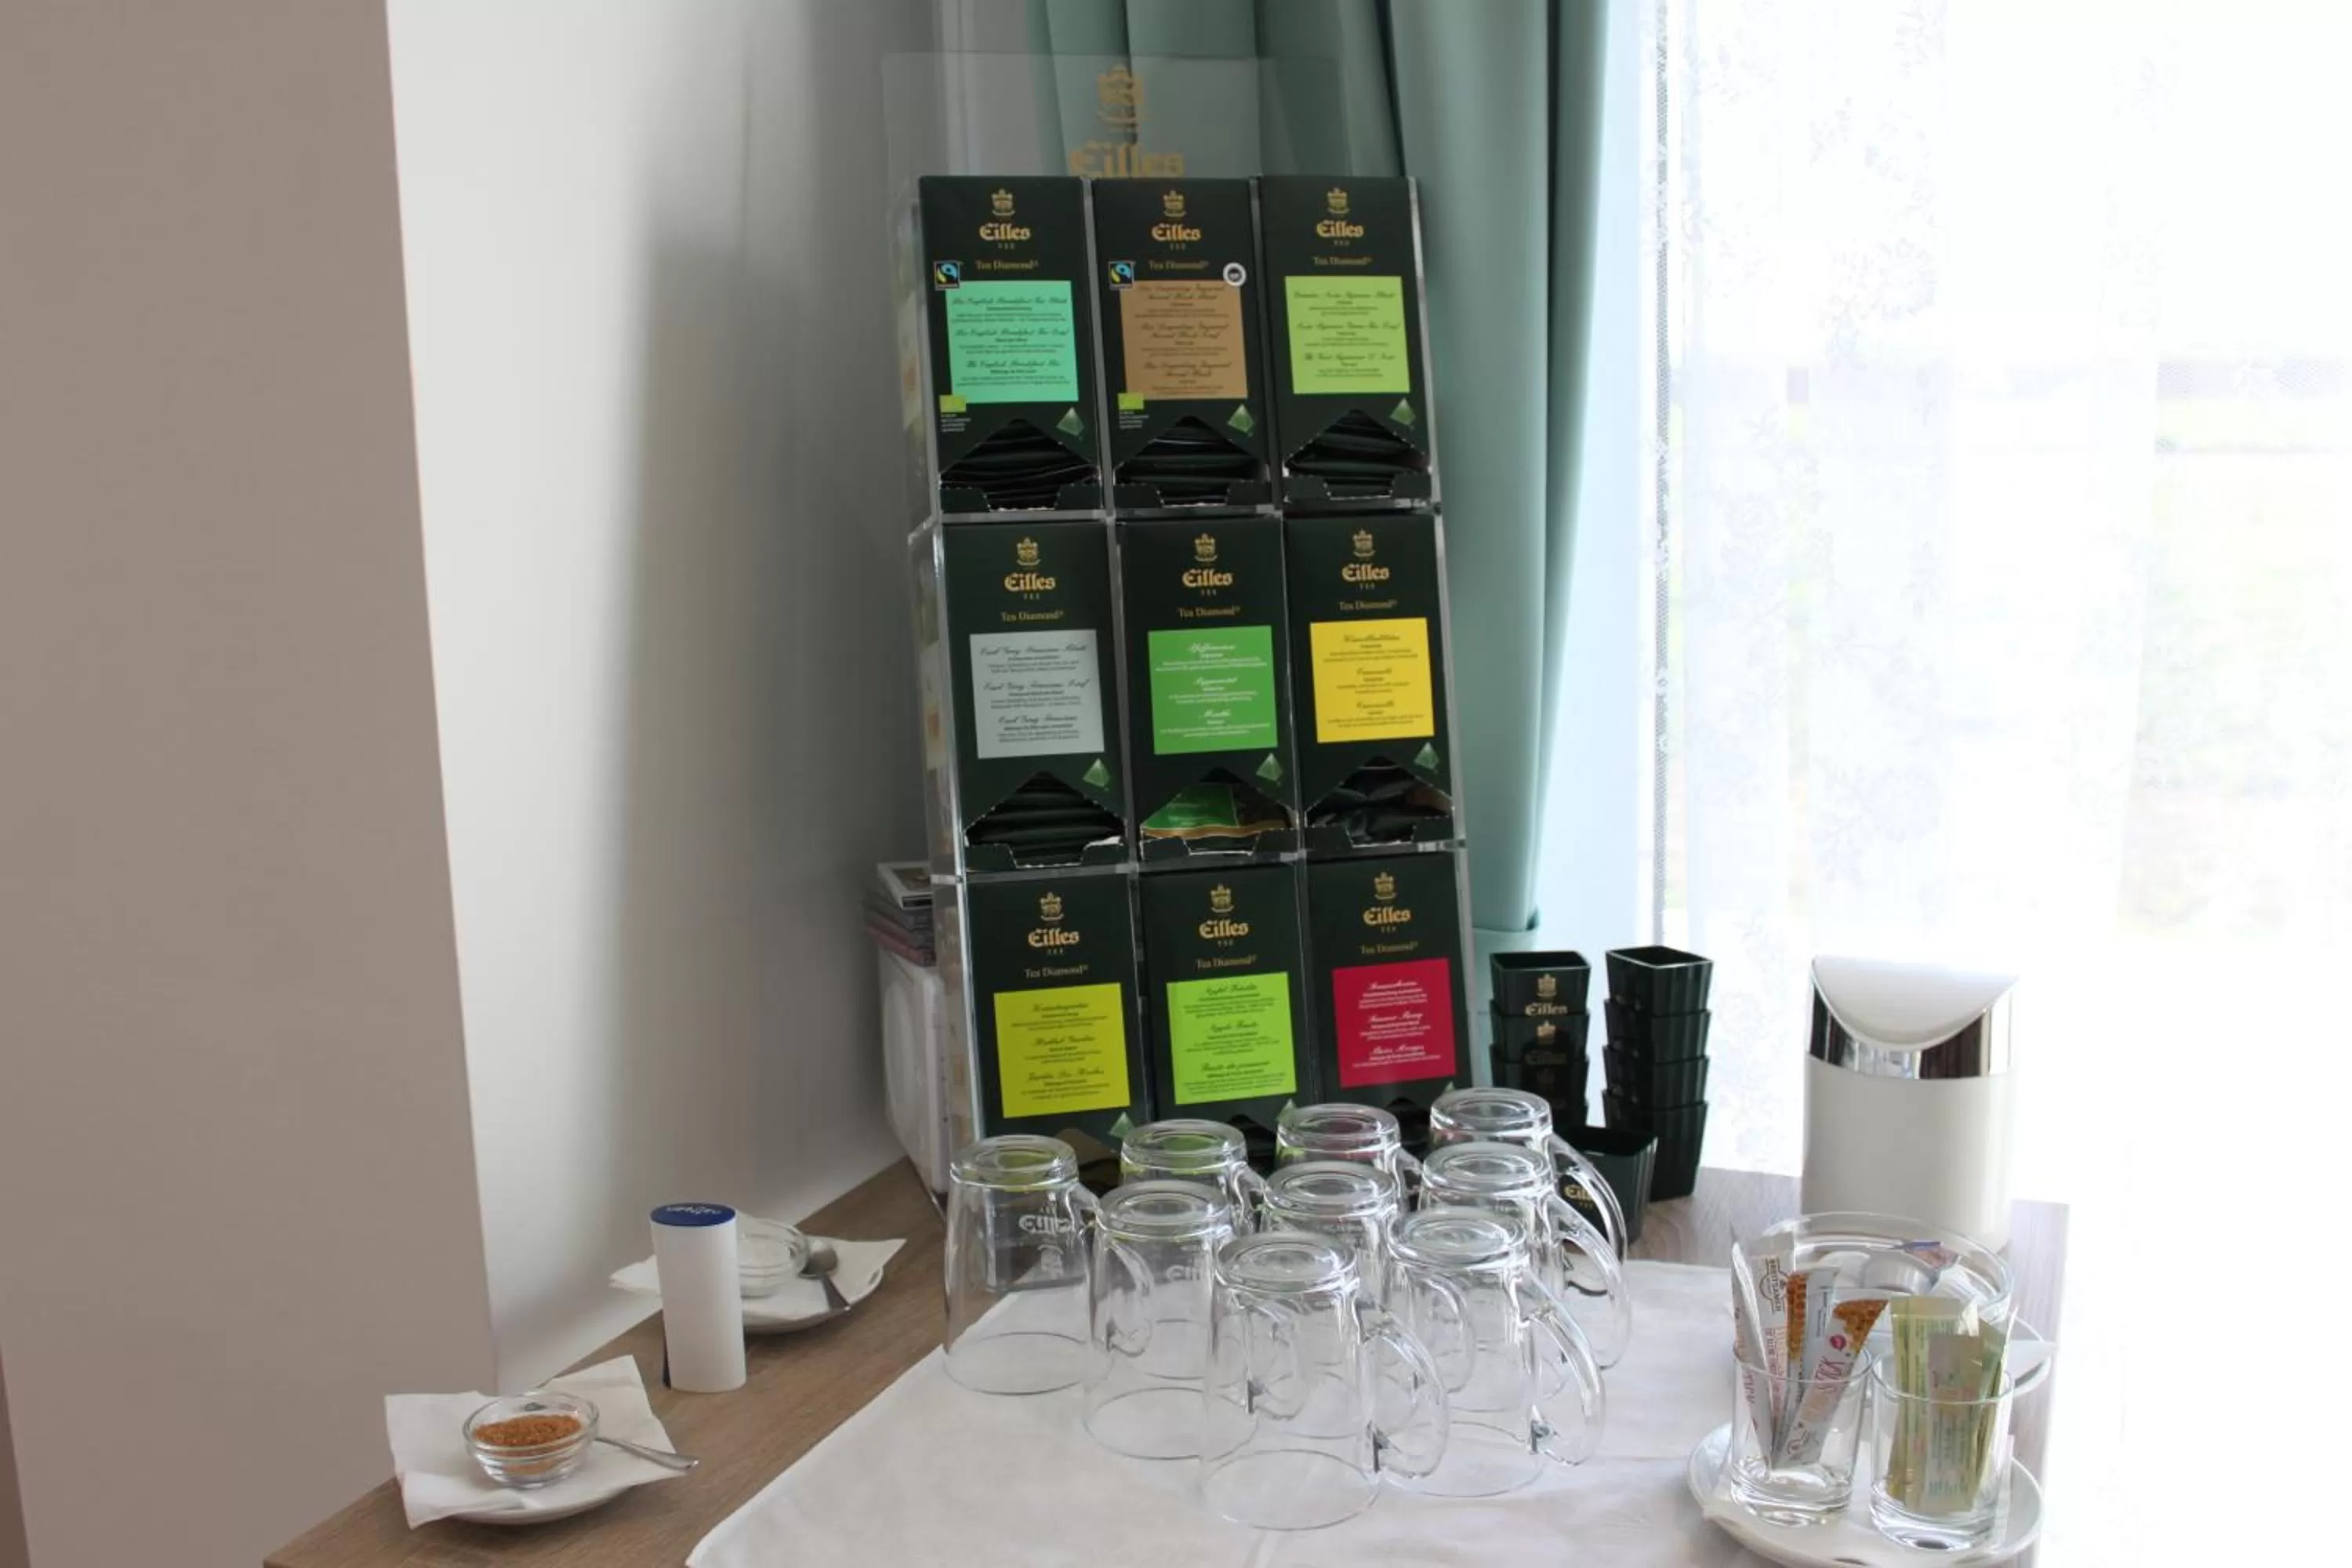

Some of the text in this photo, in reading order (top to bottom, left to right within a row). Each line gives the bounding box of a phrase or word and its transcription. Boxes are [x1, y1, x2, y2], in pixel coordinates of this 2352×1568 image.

[979, 223, 1032, 241] Eilles
[1151, 223, 1201, 241] Eilles
[1316, 220, 1364, 238] Eilles
[1004, 572, 1056, 592] Eilles
[1181, 568, 1234, 587] Eilles
[1341, 563, 1390, 582] Eilles
[1363, 906, 1412, 926] Eilles
[1027, 927, 1080, 948] Eilles
[1199, 919, 1250, 939] Eilles
[1525, 1002, 1568, 1017] Eilles
